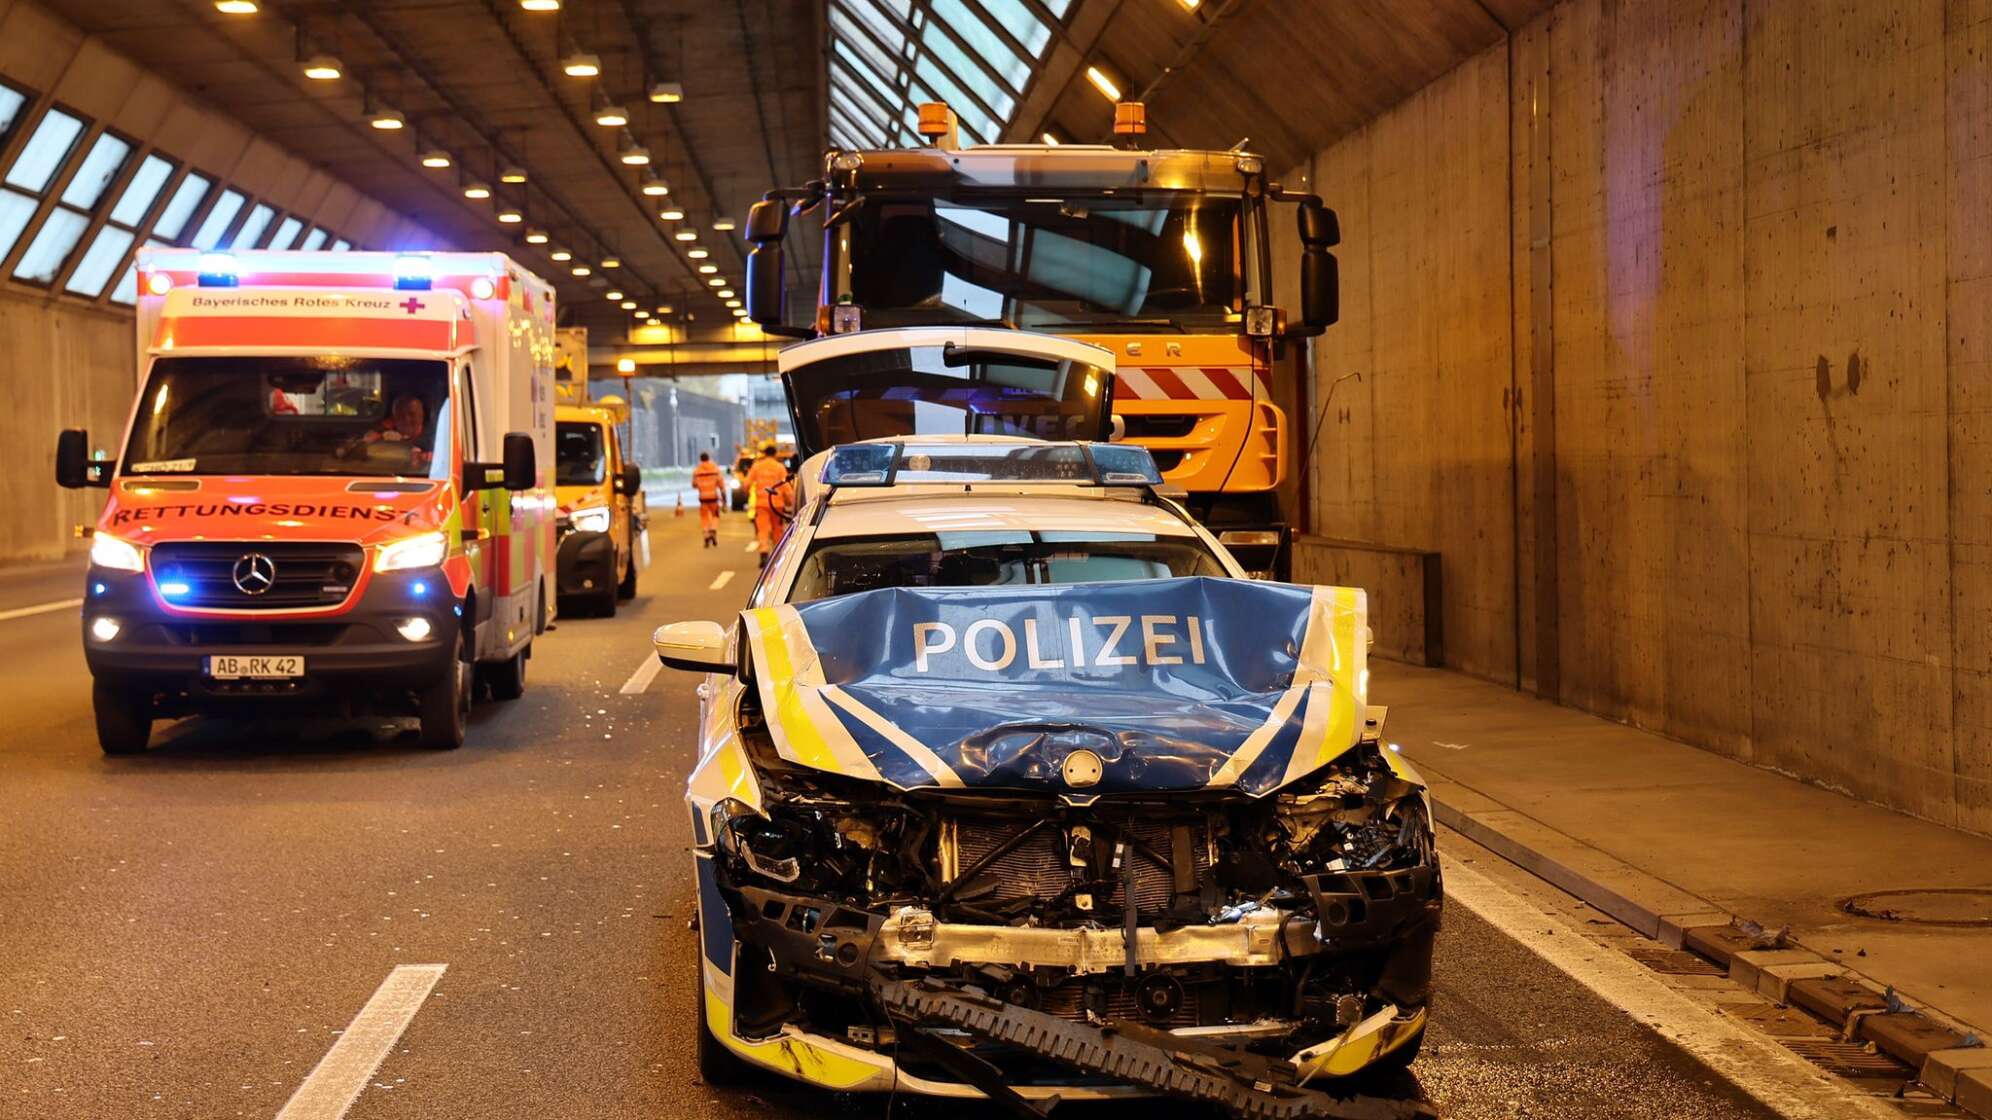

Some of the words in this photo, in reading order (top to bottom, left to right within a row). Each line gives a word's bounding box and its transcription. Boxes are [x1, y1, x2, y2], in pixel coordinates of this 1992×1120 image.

[192, 296, 288, 309] Bayerisches
[293, 297, 340, 307] Rotes
[345, 298, 391, 309] Kreuz
[113, 503, 420, 526] RETTUNGSDIENST
[913, 615, 1206, 673] POLIZEI
[217, 658, 238, 674] AB
[249, 658, 271, 674] RK
[275, 658, 297, 674] 42
